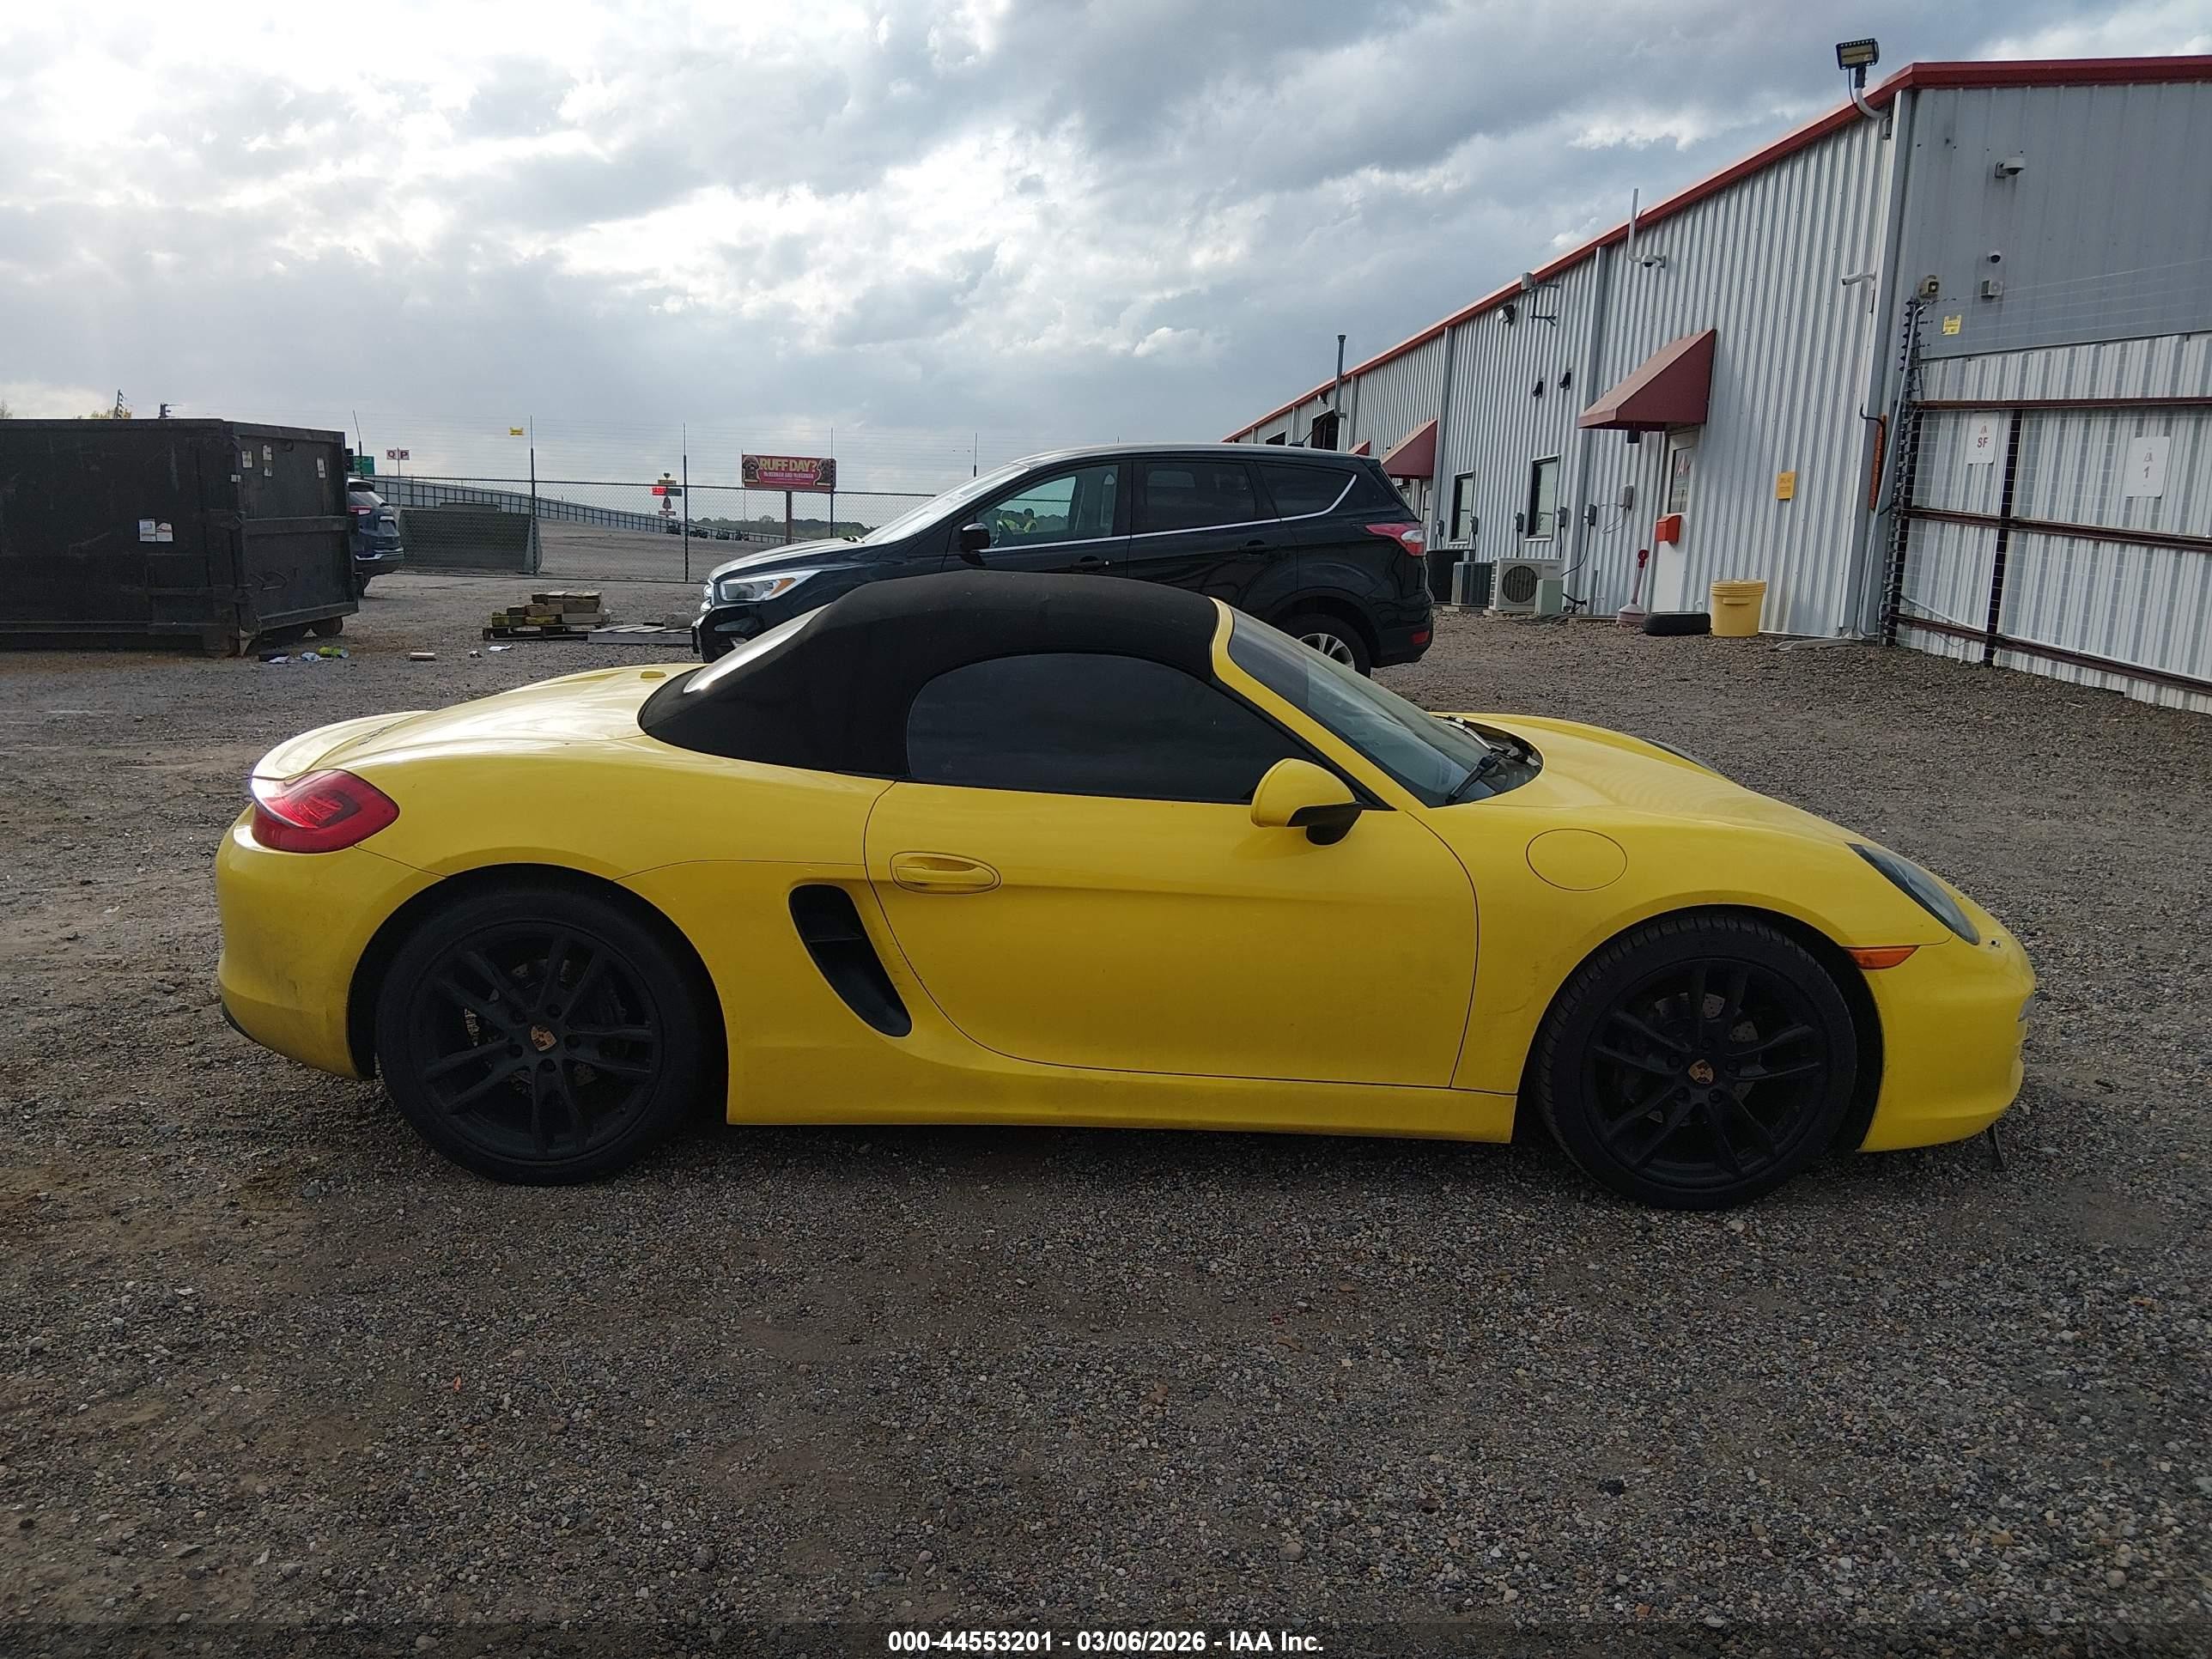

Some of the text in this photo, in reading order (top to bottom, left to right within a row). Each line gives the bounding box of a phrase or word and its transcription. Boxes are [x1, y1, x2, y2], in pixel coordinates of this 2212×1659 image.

[1977, 437, 1989, 448] SF
[387, 450, 396, 459] Q
[400, 451, 408, 459] P
[759, 458, 817, 473] RUFF DAY?
[2143, 465, 2150, 478] 1
